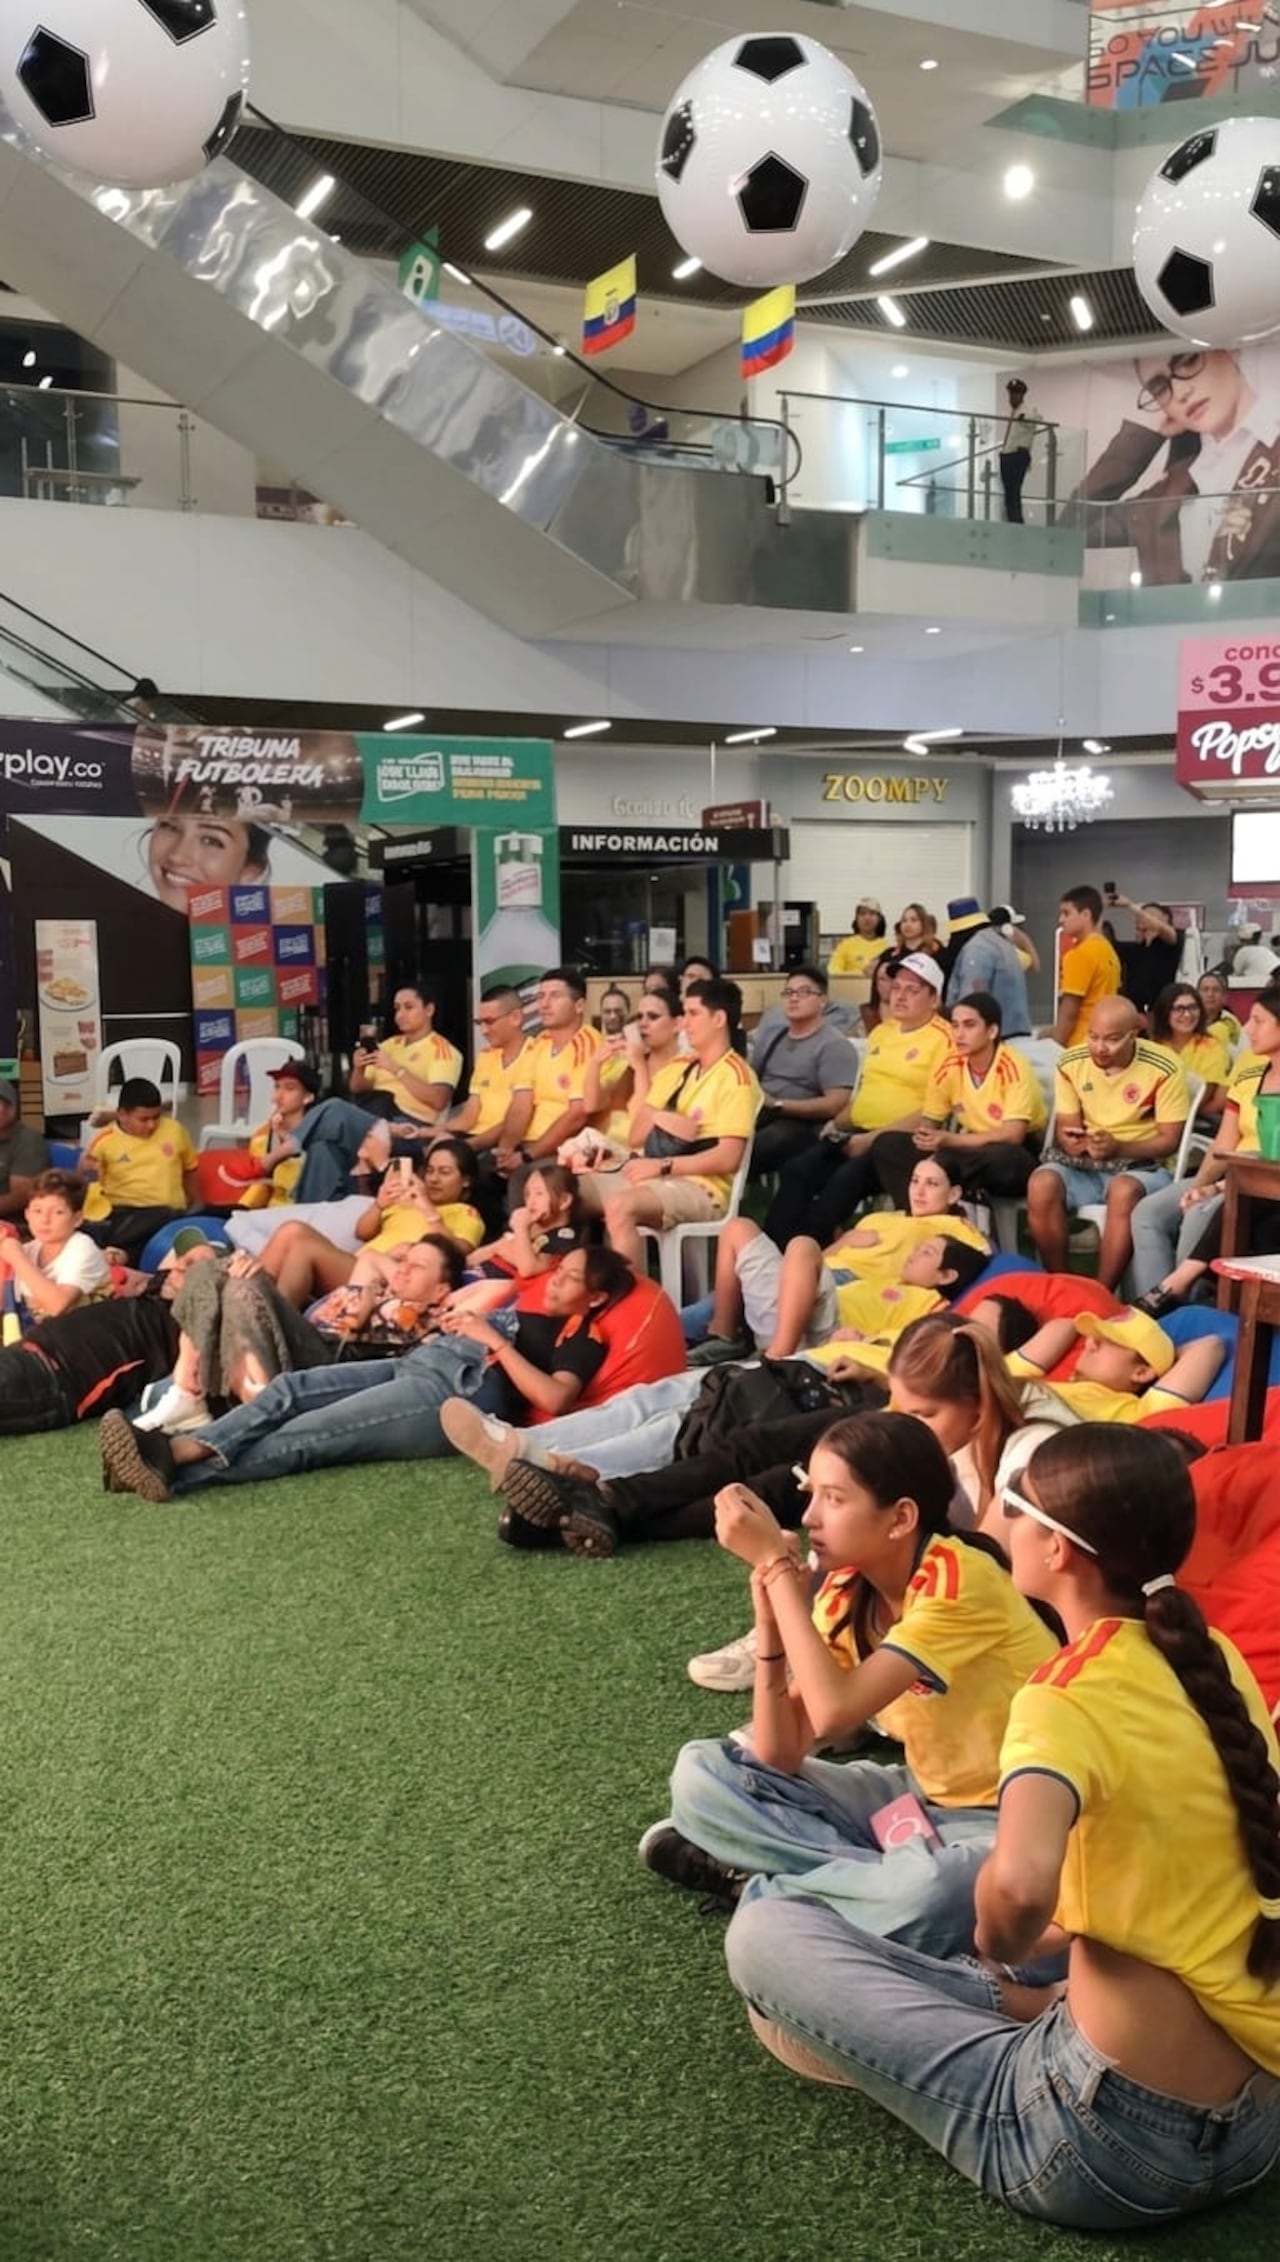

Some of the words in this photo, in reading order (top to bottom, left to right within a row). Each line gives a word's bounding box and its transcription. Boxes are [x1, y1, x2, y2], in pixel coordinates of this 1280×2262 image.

[1138, 25, 1202, 48] YOU
[1087, 48, 1218, 91] SPACE
[198, 736, 300, 758] TRIBUNA
[174, 759, 324, 788] FUTBOLERA
[823, 774, 949, 802] ZOOMPY
[572, 833, 719, 851] INFORMACIÓN
